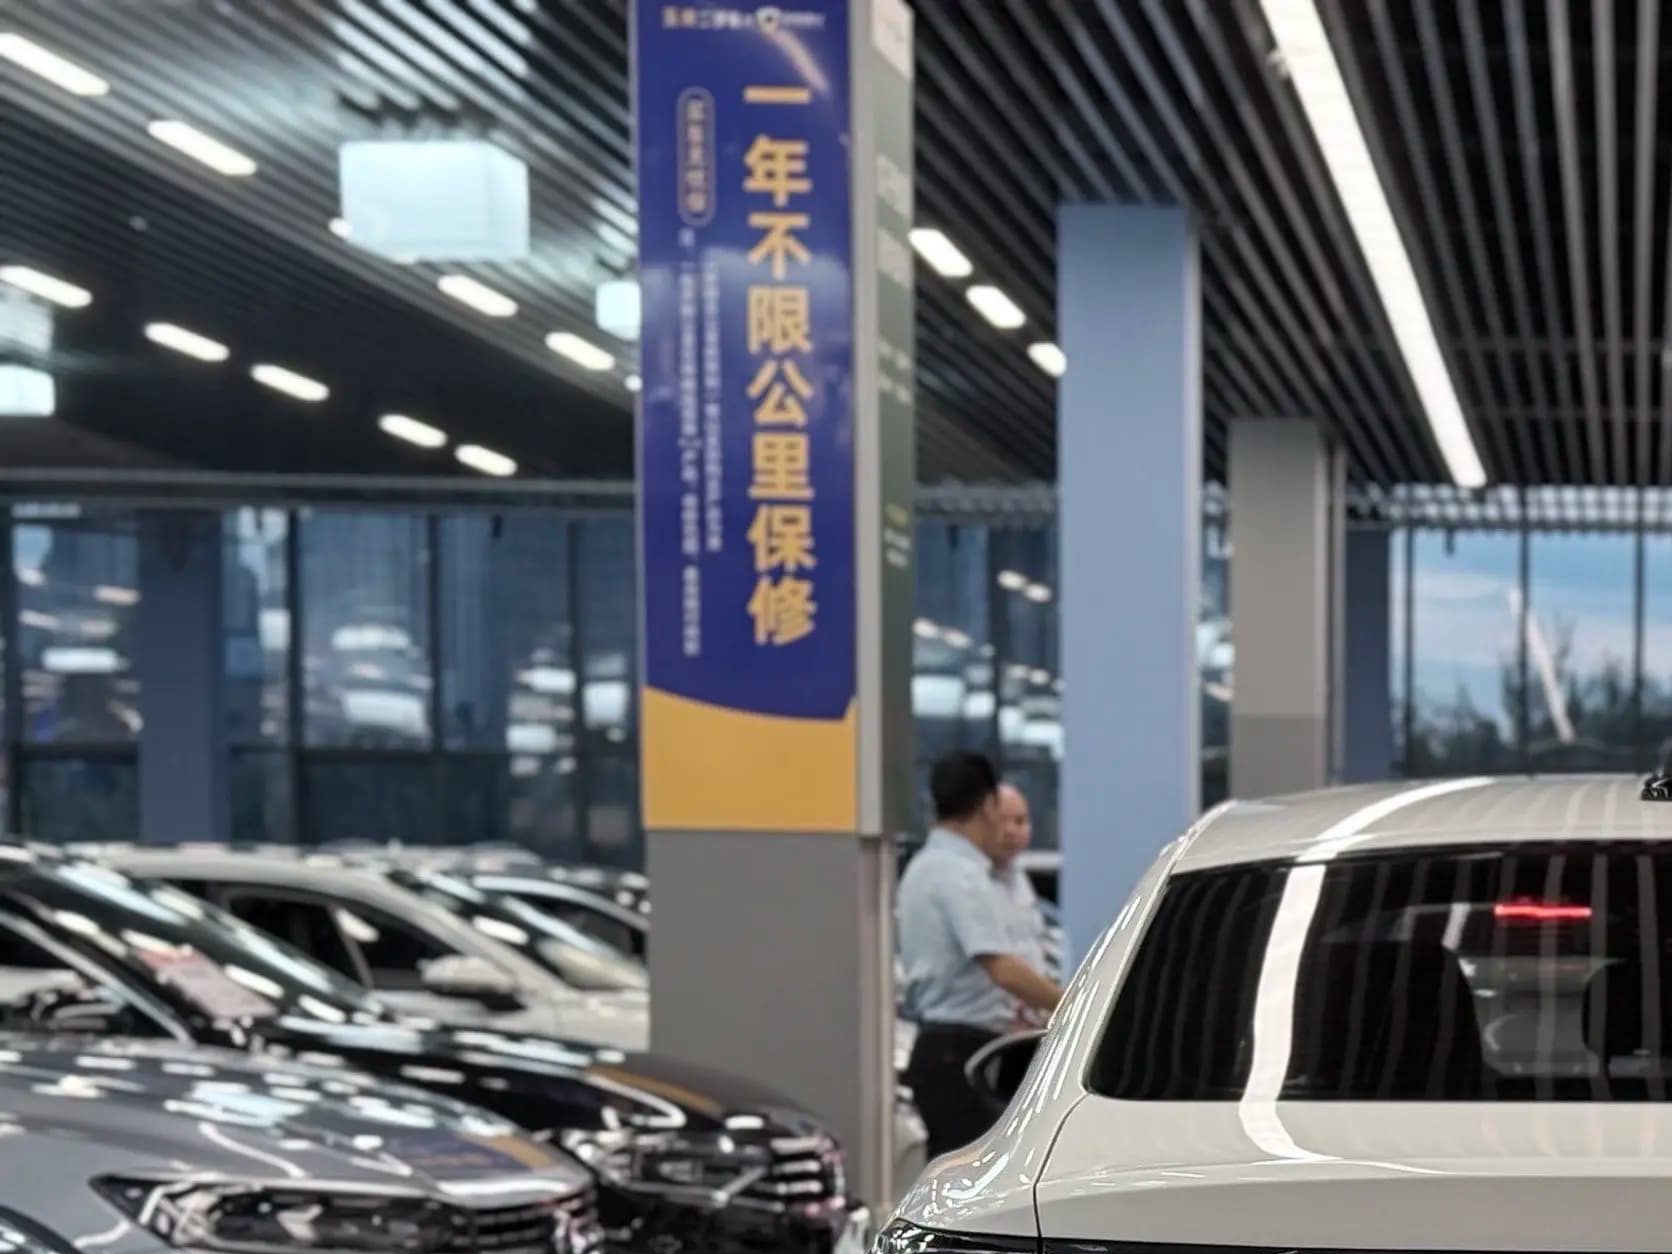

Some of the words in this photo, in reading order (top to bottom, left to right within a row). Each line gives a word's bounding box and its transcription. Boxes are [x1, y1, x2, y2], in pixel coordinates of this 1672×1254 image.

[743, 86, 817, 646] 一年不限公里保修
